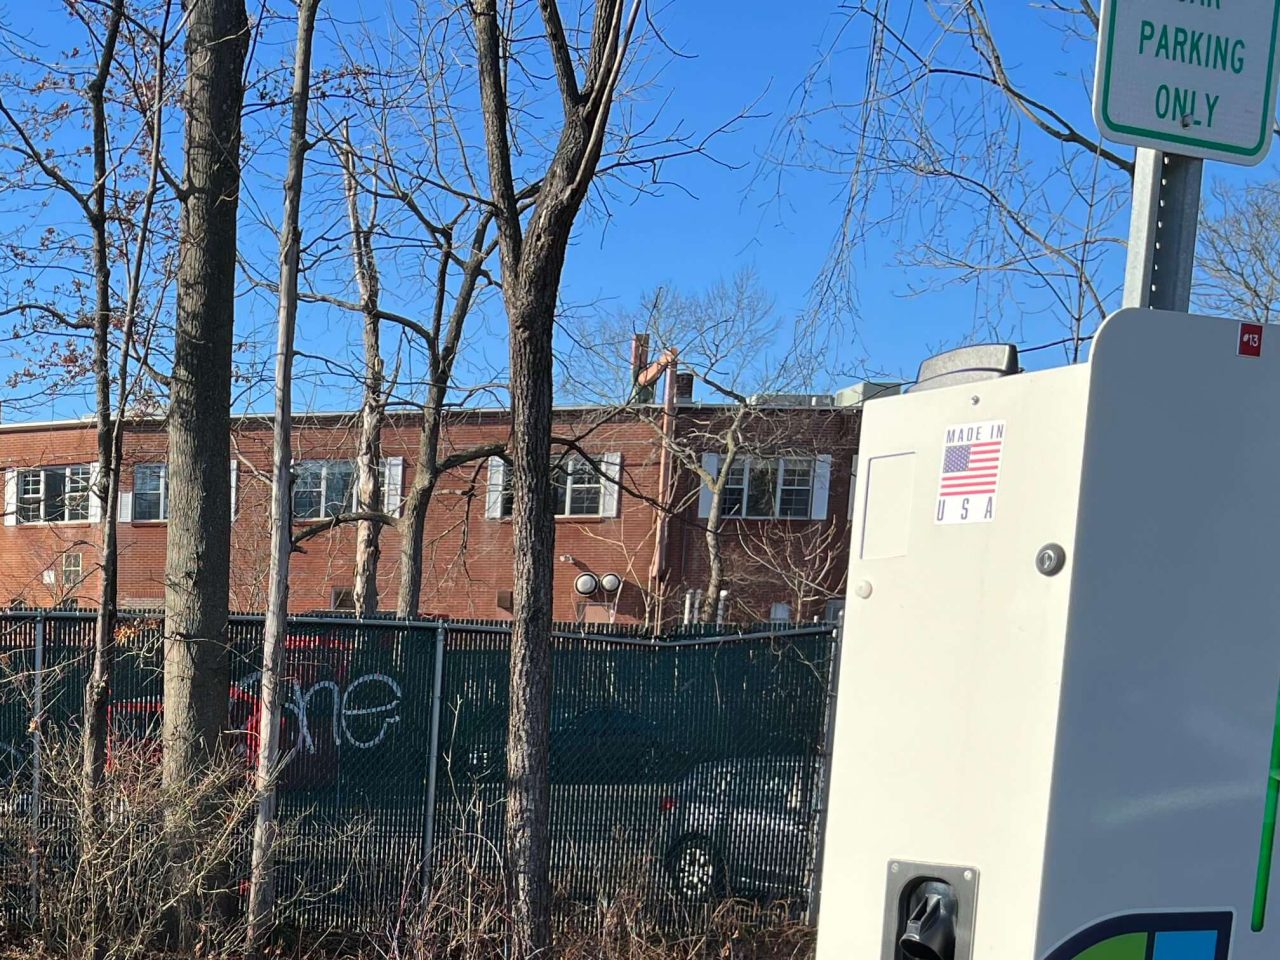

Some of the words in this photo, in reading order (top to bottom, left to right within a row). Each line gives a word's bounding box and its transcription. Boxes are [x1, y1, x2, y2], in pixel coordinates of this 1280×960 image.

[1139, 19, 1246, 75] PARKING
[1155, 83, 1220, 129] ONLY
[1242, 333, 1259, 347] #13
[946, 426, 983, 444] MADE
[990, 424, 1004, 440] IN
